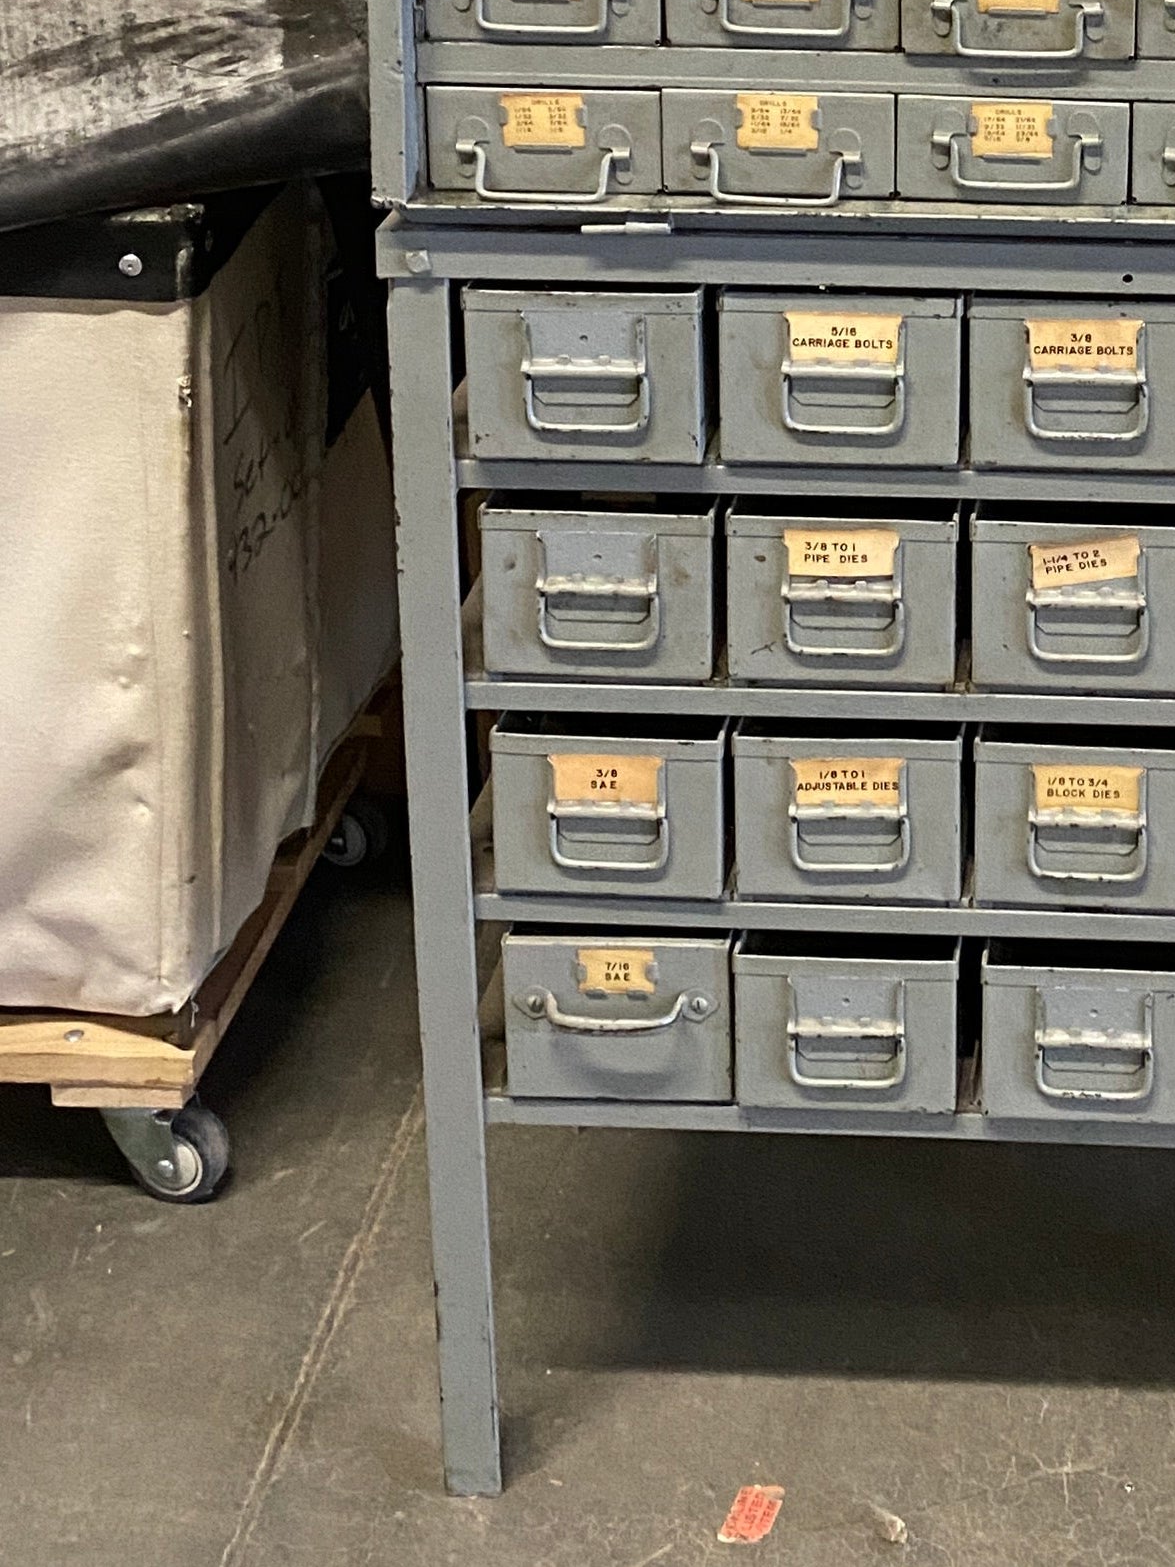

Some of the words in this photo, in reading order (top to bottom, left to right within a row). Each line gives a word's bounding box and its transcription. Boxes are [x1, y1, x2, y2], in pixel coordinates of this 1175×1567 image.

[831, 327, 857, 337] 5/16
[1070, 333, 1092, 343] 3/8
[792, 338, 850, 349] CARRIAGE
[854, 339, 893, 350] BOLTS
[1033, 345, 1092, 355] CARRIAGE
[1096, 345, 1134, 355] BOLTS
[804, 542, 827, 552] 3/8
[833, 542, 848, 552] TO
[804, 554, 830, 563] PIPE
[840, 554, 868, 563] DIES
[1073, 551, 1089, 560] TO
[1092, 549, 1100, 558] 2
[1045, 562, 1073, 574] PIPE
[1078, 558, 1107, 569] DIES
[596, 769, 618, 778] 3/8
[820, 771, 837, 779] 1/8
[842, 770, 858, 779] TO
[590, 780, 617, 790] SAE
[796, 781, 868, 791] ADJUSTABLE
[872, 781, 899, 791] DIES
[1048, 777, 1066, 786] 1/8
[1069, 777, 1085, 787] TO
[1088, 778, 1108, 788] 3/4
[1046, 788, 1086, 798] BLOCK
[1093, 789, 1120, 799] DIES
[605, 962, 629, 971] 7/16
[605, 972, 631, 981] SAE
